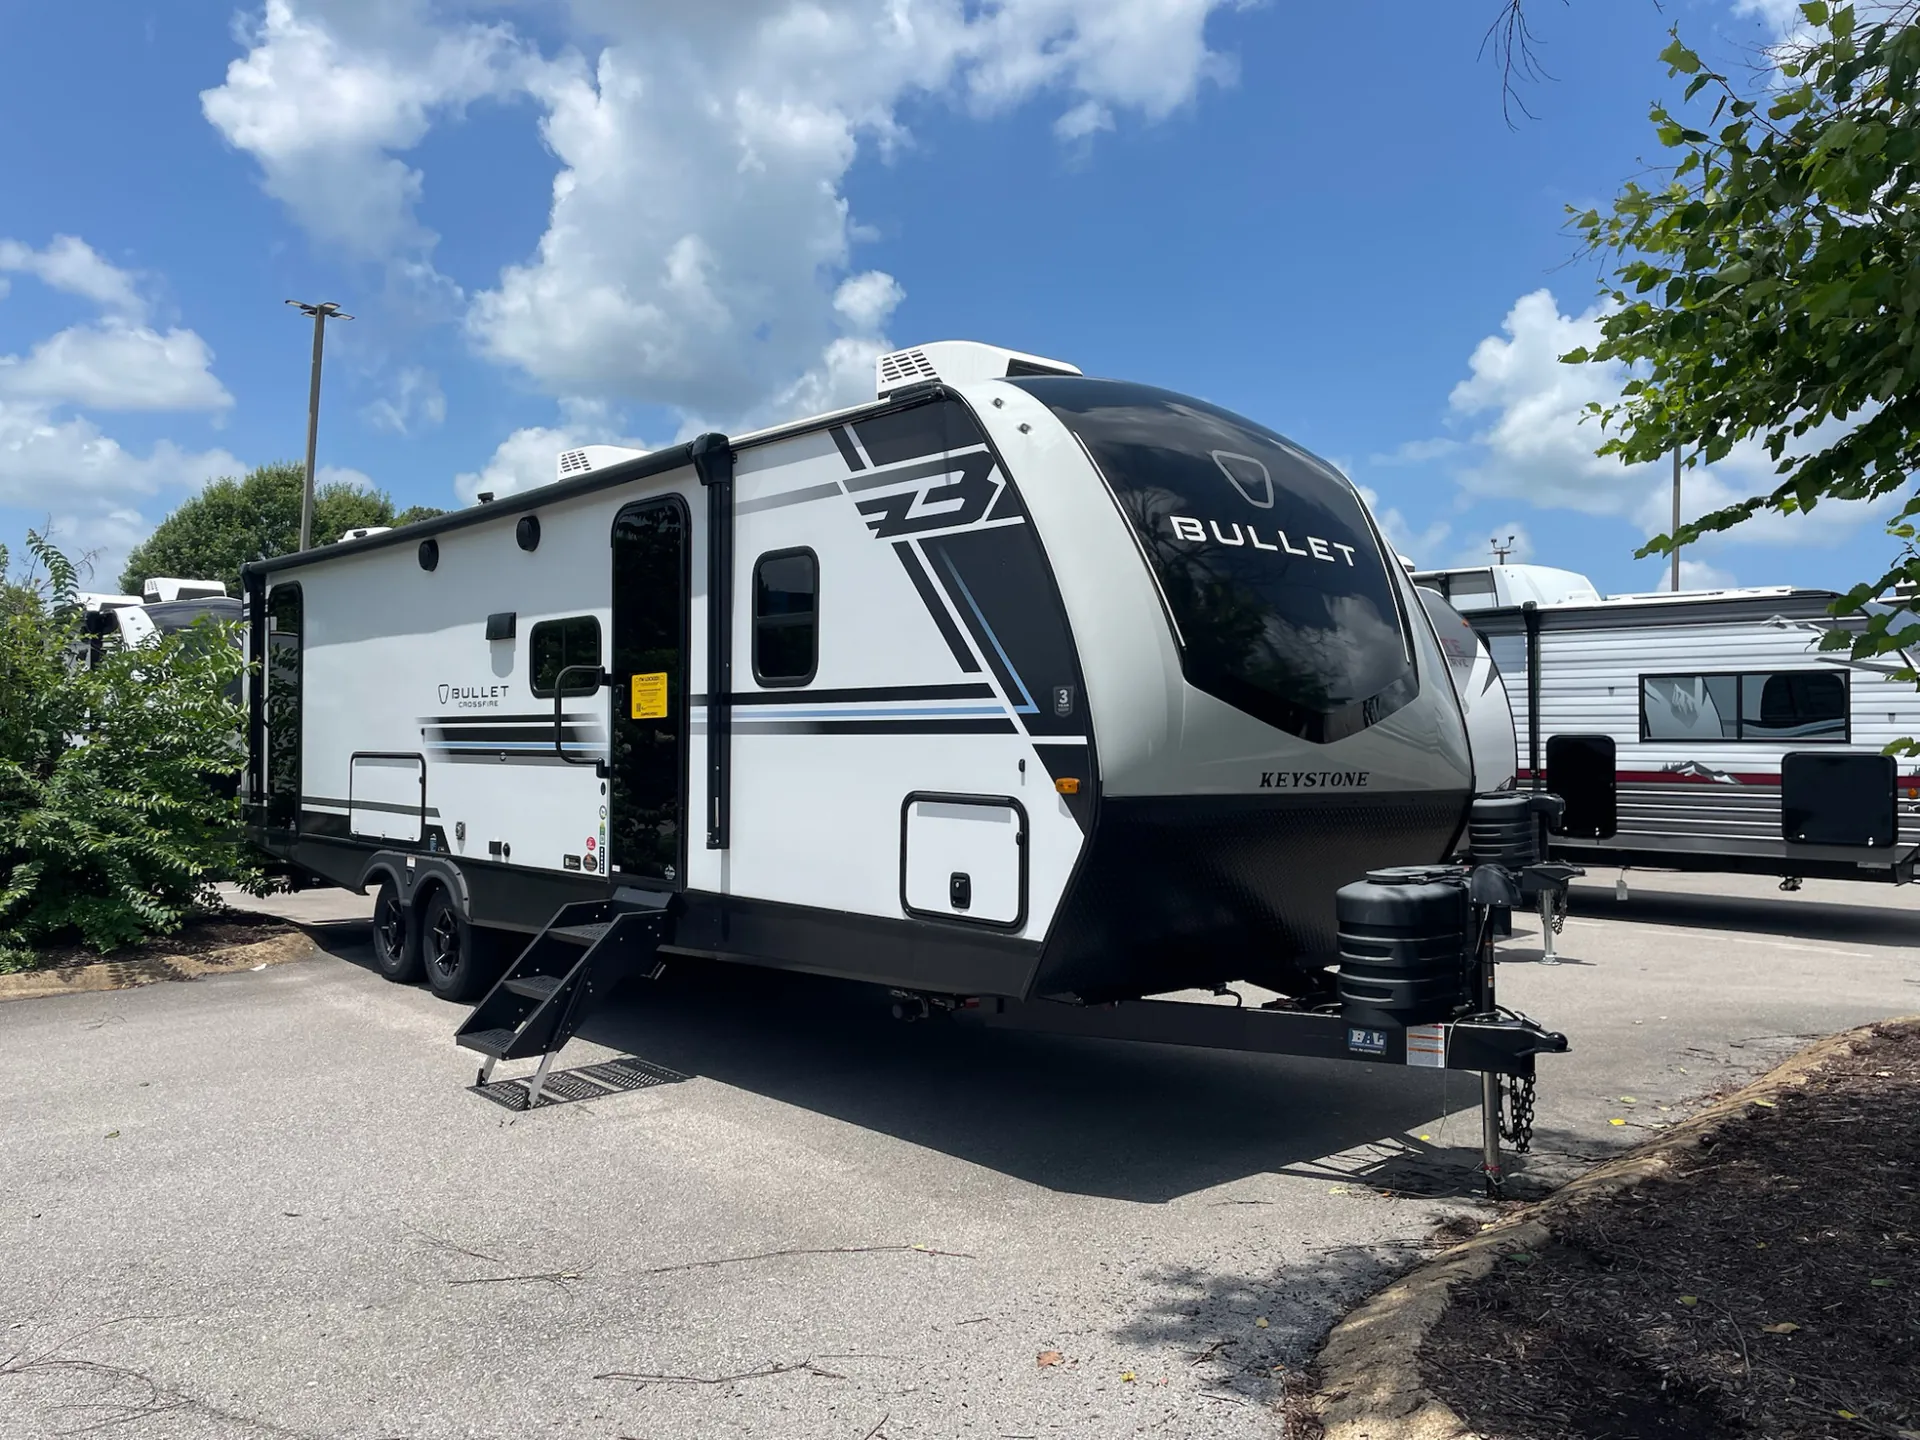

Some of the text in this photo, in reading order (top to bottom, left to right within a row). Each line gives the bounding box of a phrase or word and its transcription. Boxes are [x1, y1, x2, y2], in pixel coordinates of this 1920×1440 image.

[1169, 515, 1356, 567] BULLET
[451, 685, 509, 699] BULLET
[1059, 689, 1069, 704] 3
[458, 700, 499, 708] CROSSFIRE
[1259, 771, 1370, 788] KEYSTONE
